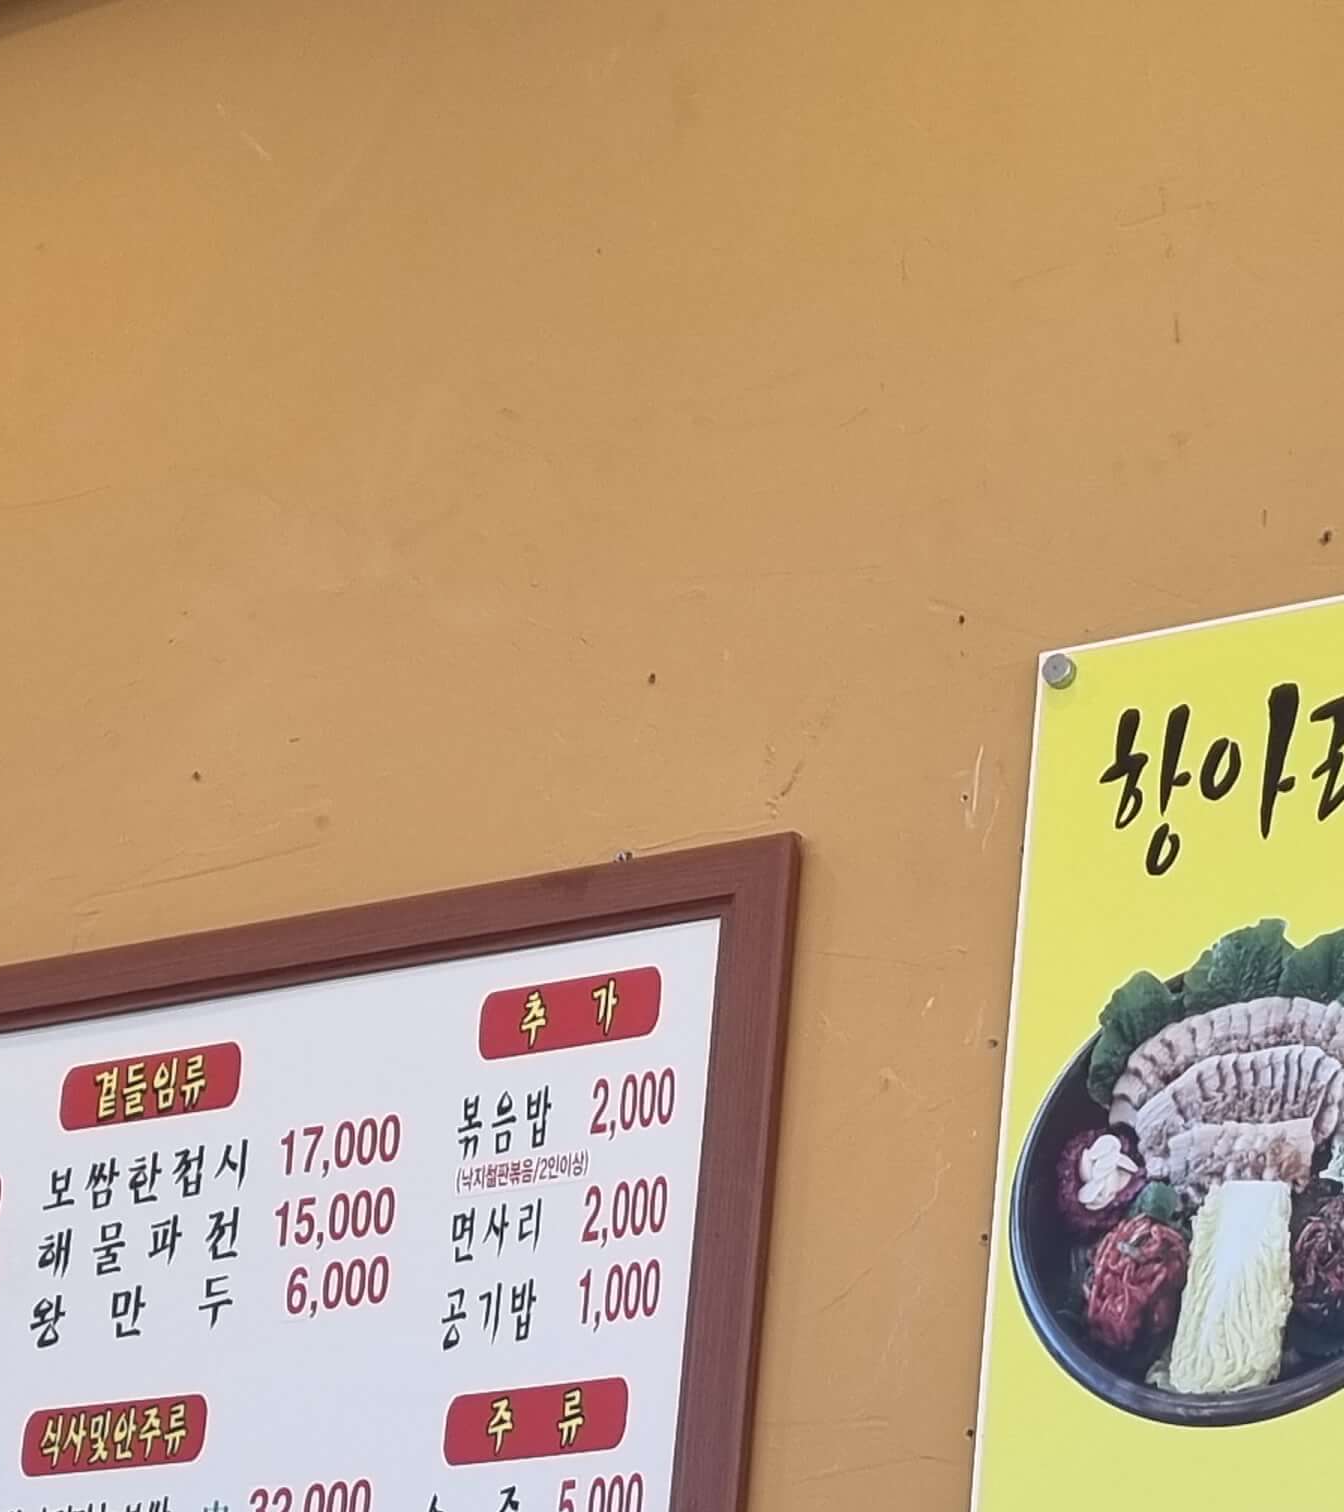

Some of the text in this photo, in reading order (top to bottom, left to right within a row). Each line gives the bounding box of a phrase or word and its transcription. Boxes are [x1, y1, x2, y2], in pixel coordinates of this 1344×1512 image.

[96, 1054, 206, 1120] 곁들임류
[457, 1067, 676, 1161] 볶음밥 2,000
[281, 1113, 401, 1178] 17,000
[274, 1187, 396, 1250] 15,000
[451, 1176, 668, 1263] 면사리 2,000
[286, 1255, 390, 1318] 6,000
[441, 1258, 660, 1350] 공기밥 1,000
[40, 1403, 188, 1466] 식사및안주류
